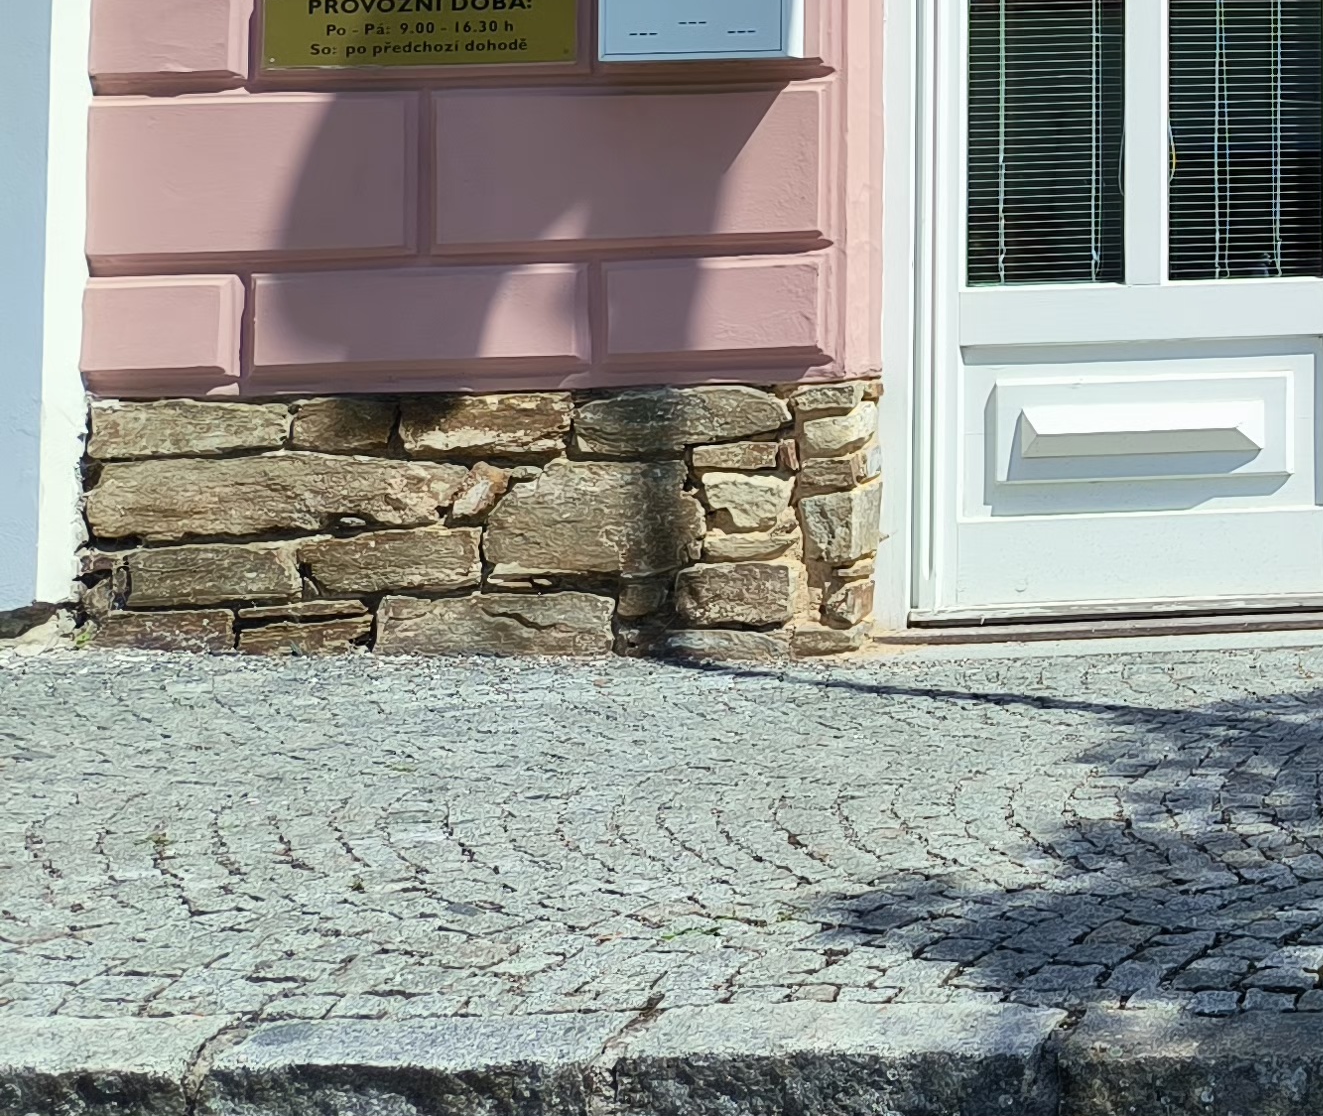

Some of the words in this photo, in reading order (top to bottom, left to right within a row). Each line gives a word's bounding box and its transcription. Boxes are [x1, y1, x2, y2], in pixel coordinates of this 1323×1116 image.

[326, 24, 346, 36] Po
[364, 23, 391, 35] Pá:
[400, 22, 435, 34] 9.00
[455, 20, 498, 33] 16.30
[504, 20, 514, 32] h
[310, 43, 337, 55] So:
[345, 44, 367, 58] po
[372, 40, 459, 57] předchozí
[464, 38, 528, 53] dohodě
